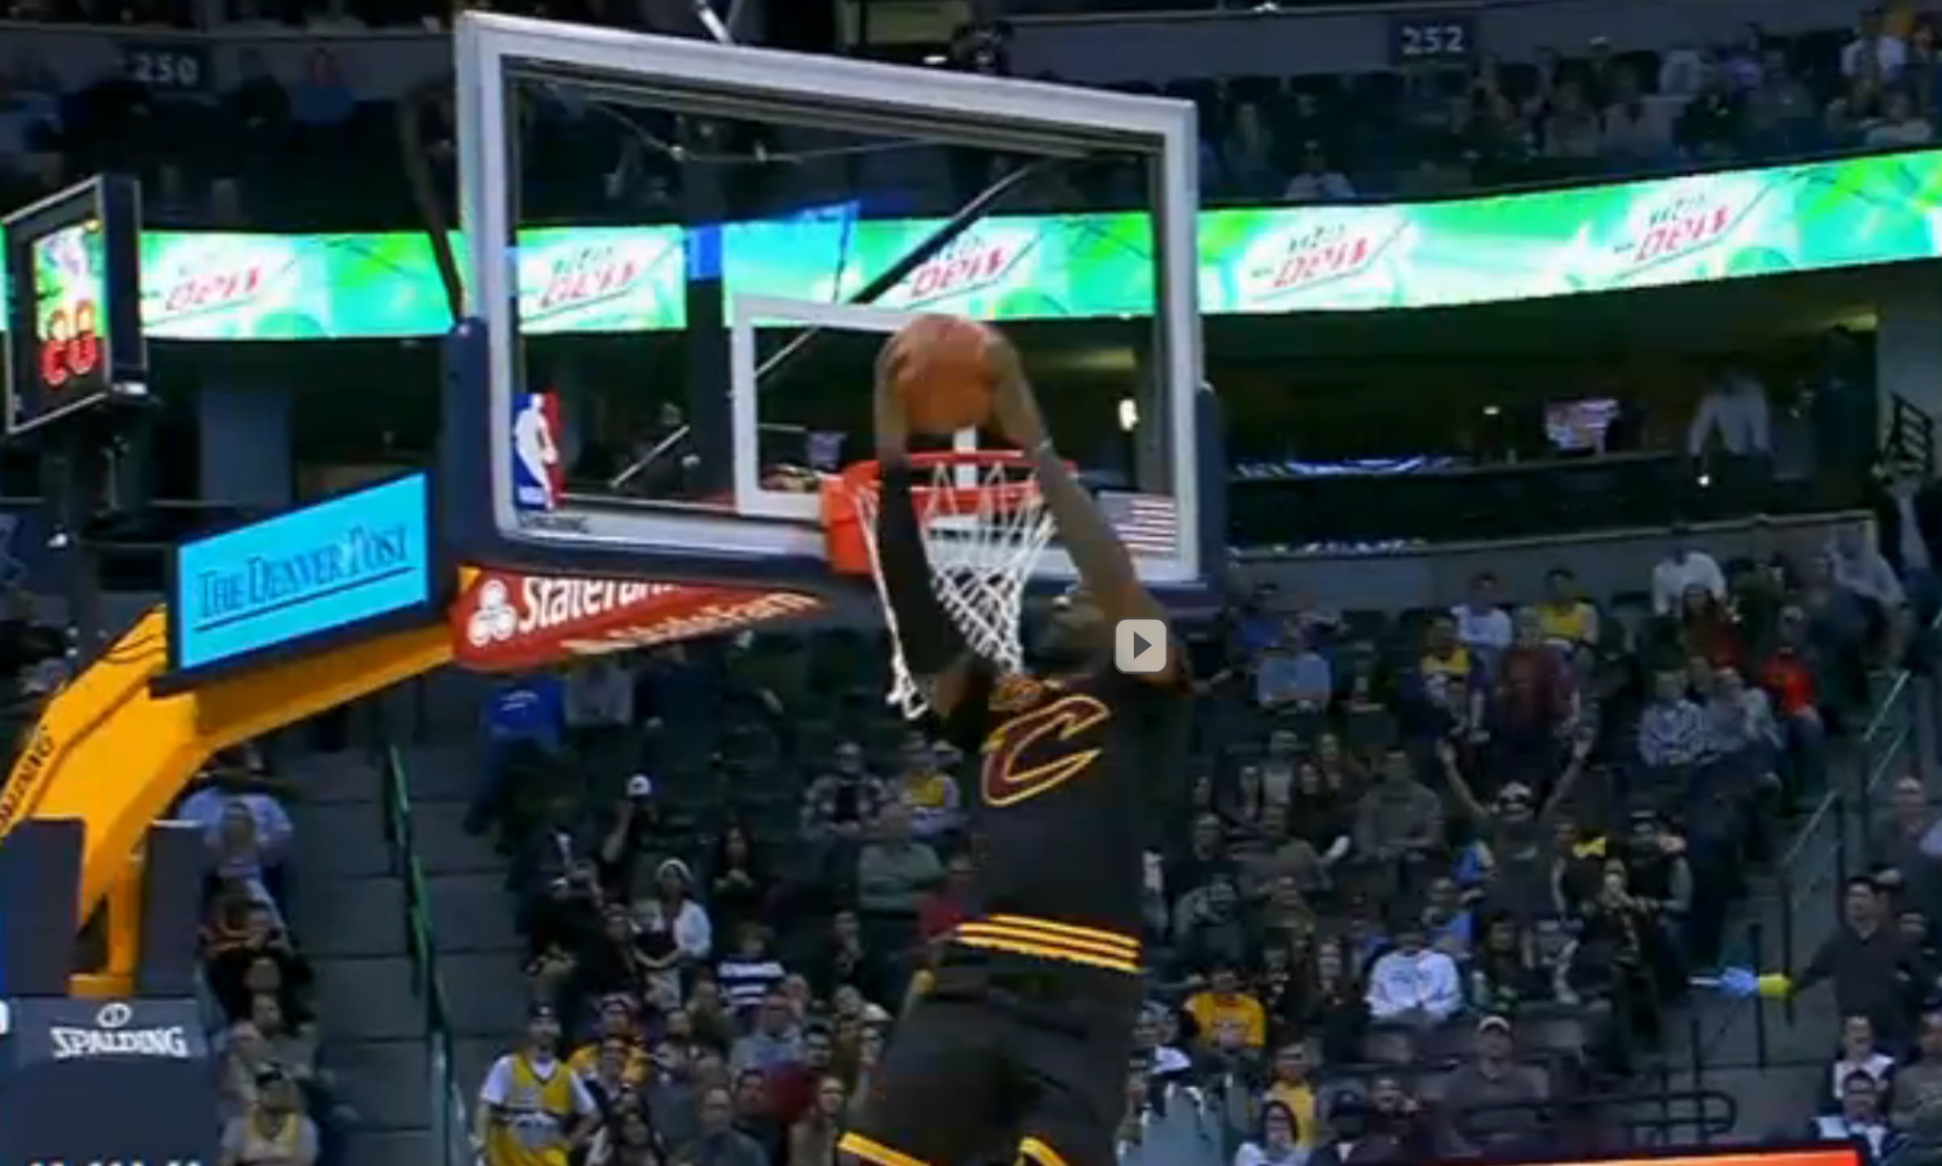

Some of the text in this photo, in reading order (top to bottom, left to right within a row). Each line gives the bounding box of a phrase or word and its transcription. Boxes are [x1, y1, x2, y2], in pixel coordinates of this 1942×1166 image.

[1402, 27, 1464, 54] 252
[137, 53, 198, 84] 250
[50, 1025, 189, 1059] SPALDING
